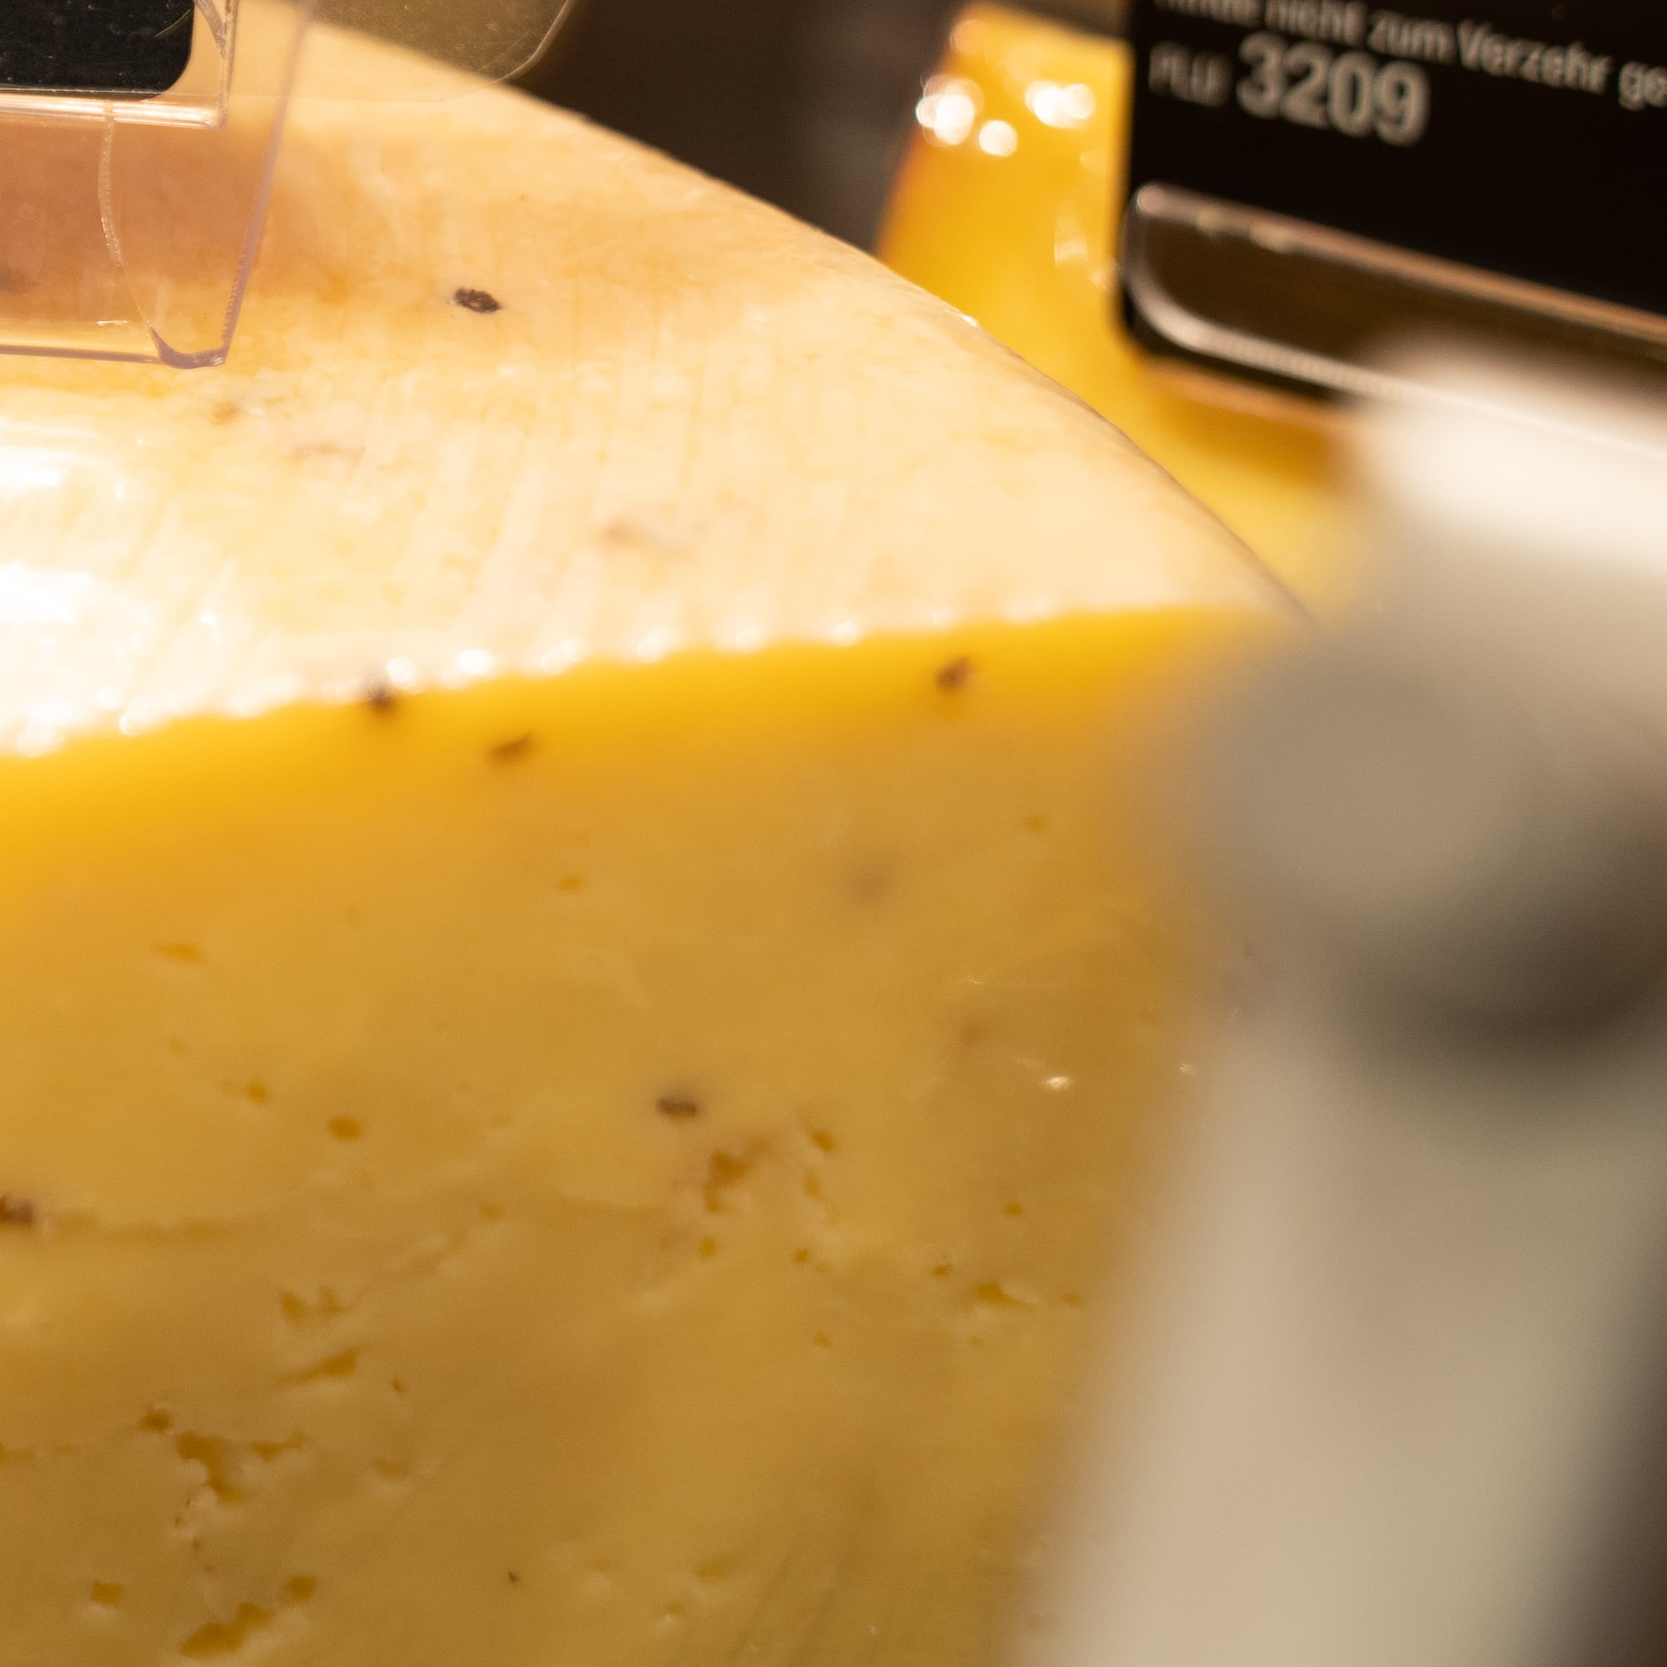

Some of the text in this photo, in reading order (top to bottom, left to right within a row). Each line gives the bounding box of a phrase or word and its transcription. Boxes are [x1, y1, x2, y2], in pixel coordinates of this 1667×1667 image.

[1235, 31, 1431, 148] 3209
[1368, 8, 1456, 65] zum
[1457, 18, 1613, 95] Verzehr
